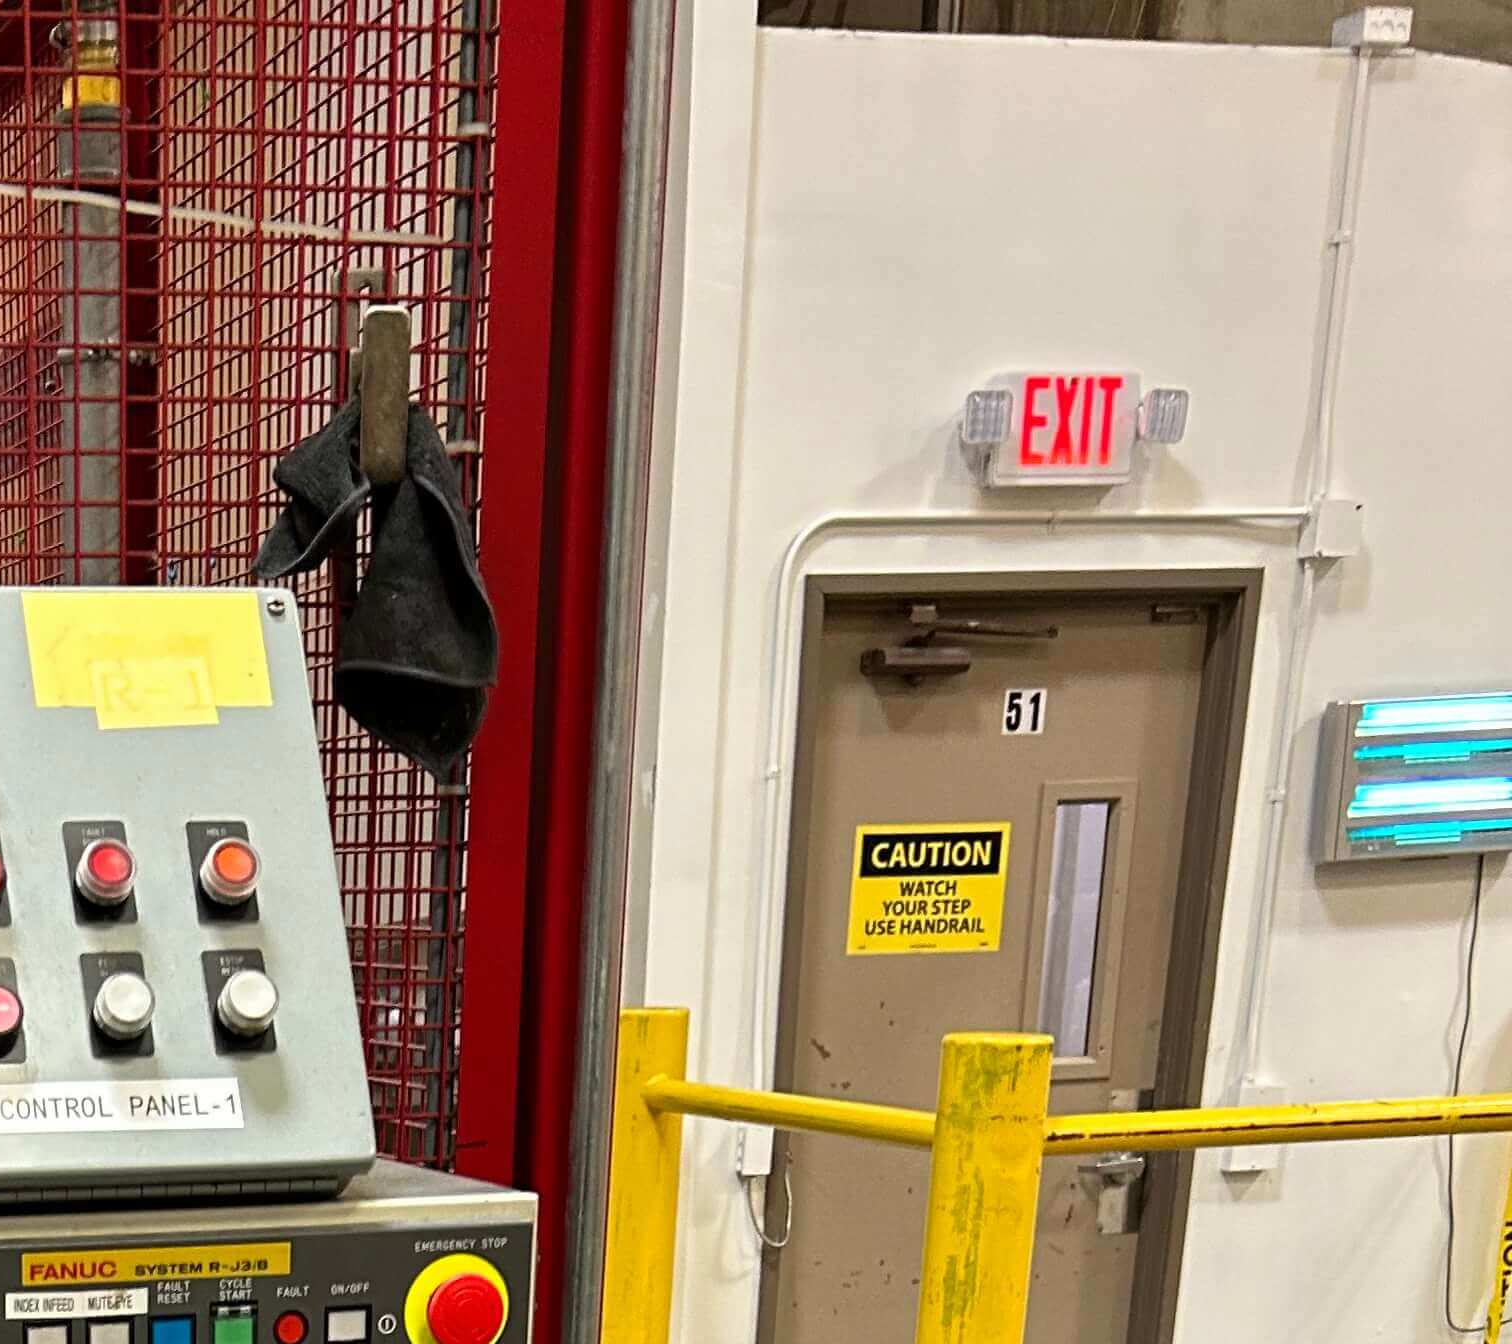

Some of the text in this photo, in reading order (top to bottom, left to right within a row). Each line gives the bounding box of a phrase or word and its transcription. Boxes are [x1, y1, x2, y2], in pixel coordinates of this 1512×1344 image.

[1019, 376, 1124, 466] EXIT
[1005, 692, 1042, 731] 51
[871, 840, 992, 869] CAUTION
[899, 880, 957, 896] WATCH
[882, 899, 971, 916] YOUR STEP
[864, 918, 984, 935] USE HANDRAIL
[129, 1094, 237, 1118] PANEL-1
[414, 1237, 508, 1252] EMERGENCY STOP
[29, 1261, 118, 1281] FANUC
[134, 1262, 203, 1276] SYSTEM
[157, 1280, 191, 1292] FAULT
[219, 1278, 253, 1290] CYCLE
[276, 1285, 310, 1298] FAULT
[330, 1281, 370, 1296] ON/OFF
[157, 1292, 191, 1304] RESET
[219, 1289, 253, 1301] START
